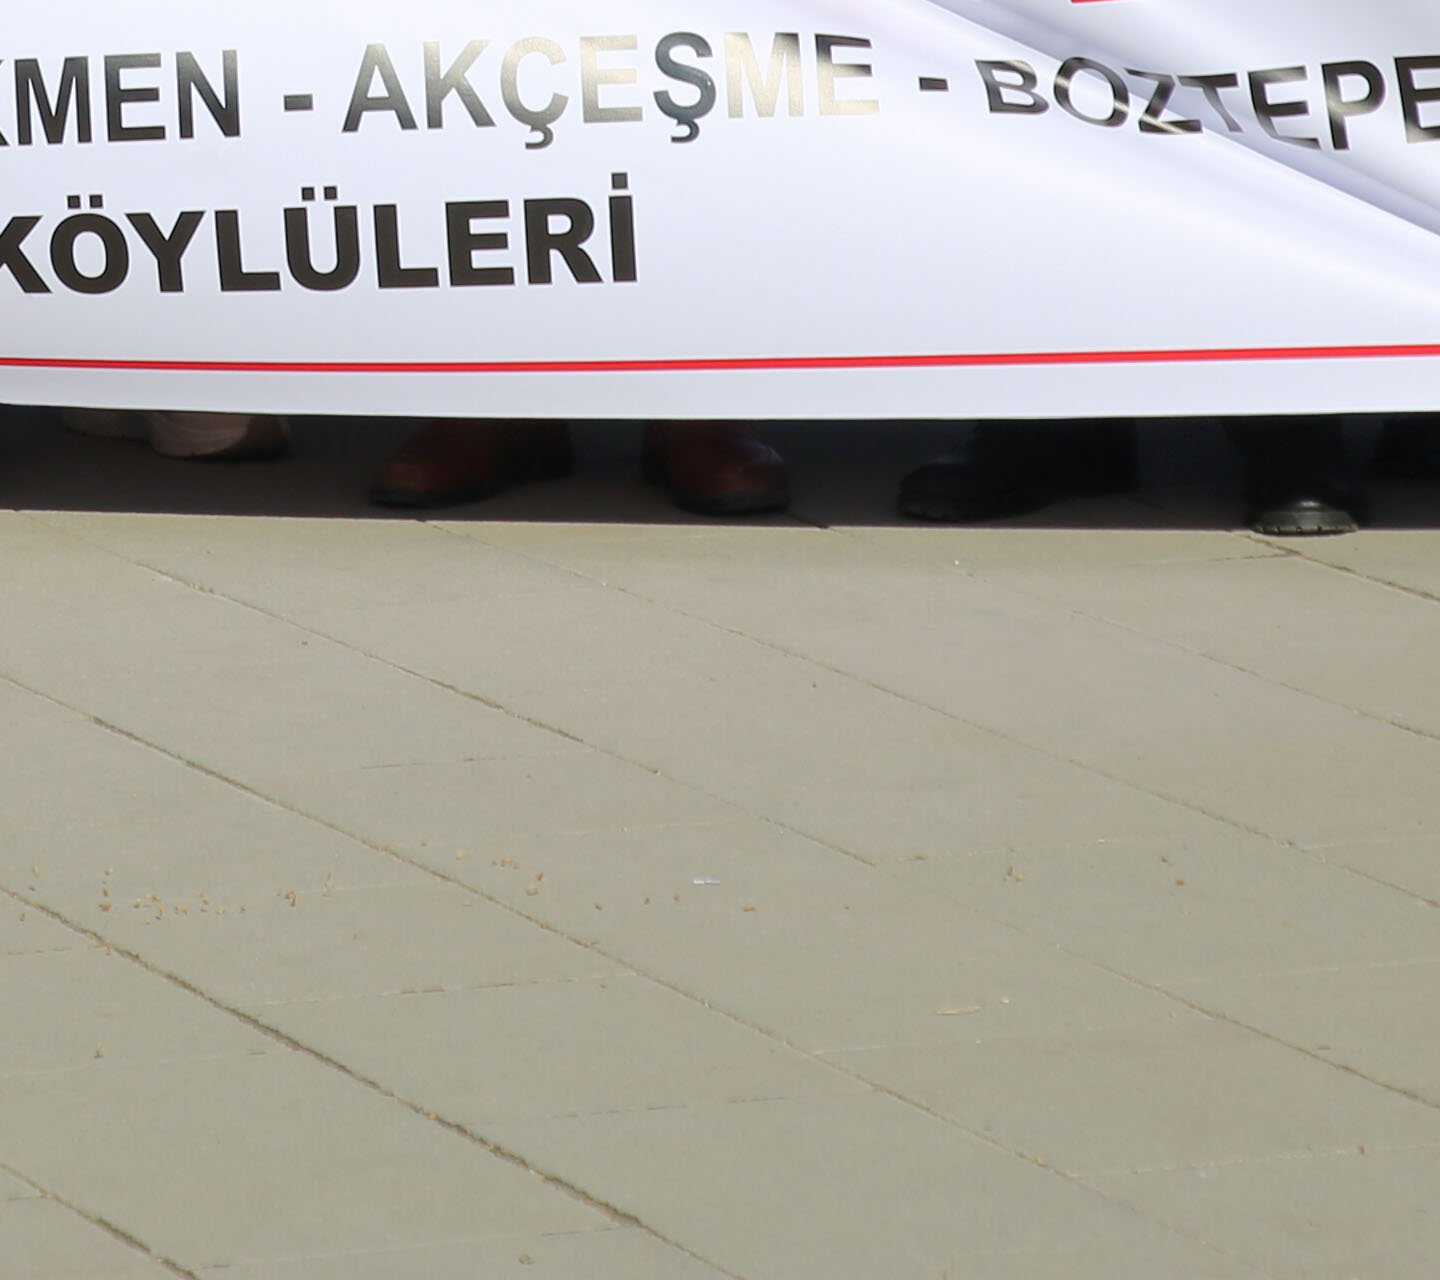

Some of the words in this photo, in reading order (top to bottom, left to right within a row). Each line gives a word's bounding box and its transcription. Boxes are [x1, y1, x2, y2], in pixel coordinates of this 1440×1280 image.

[283, 90, 311, 112] -
[342, 30, 880, 150] AKÇEŞME
[918, 75, 949, 91] -
